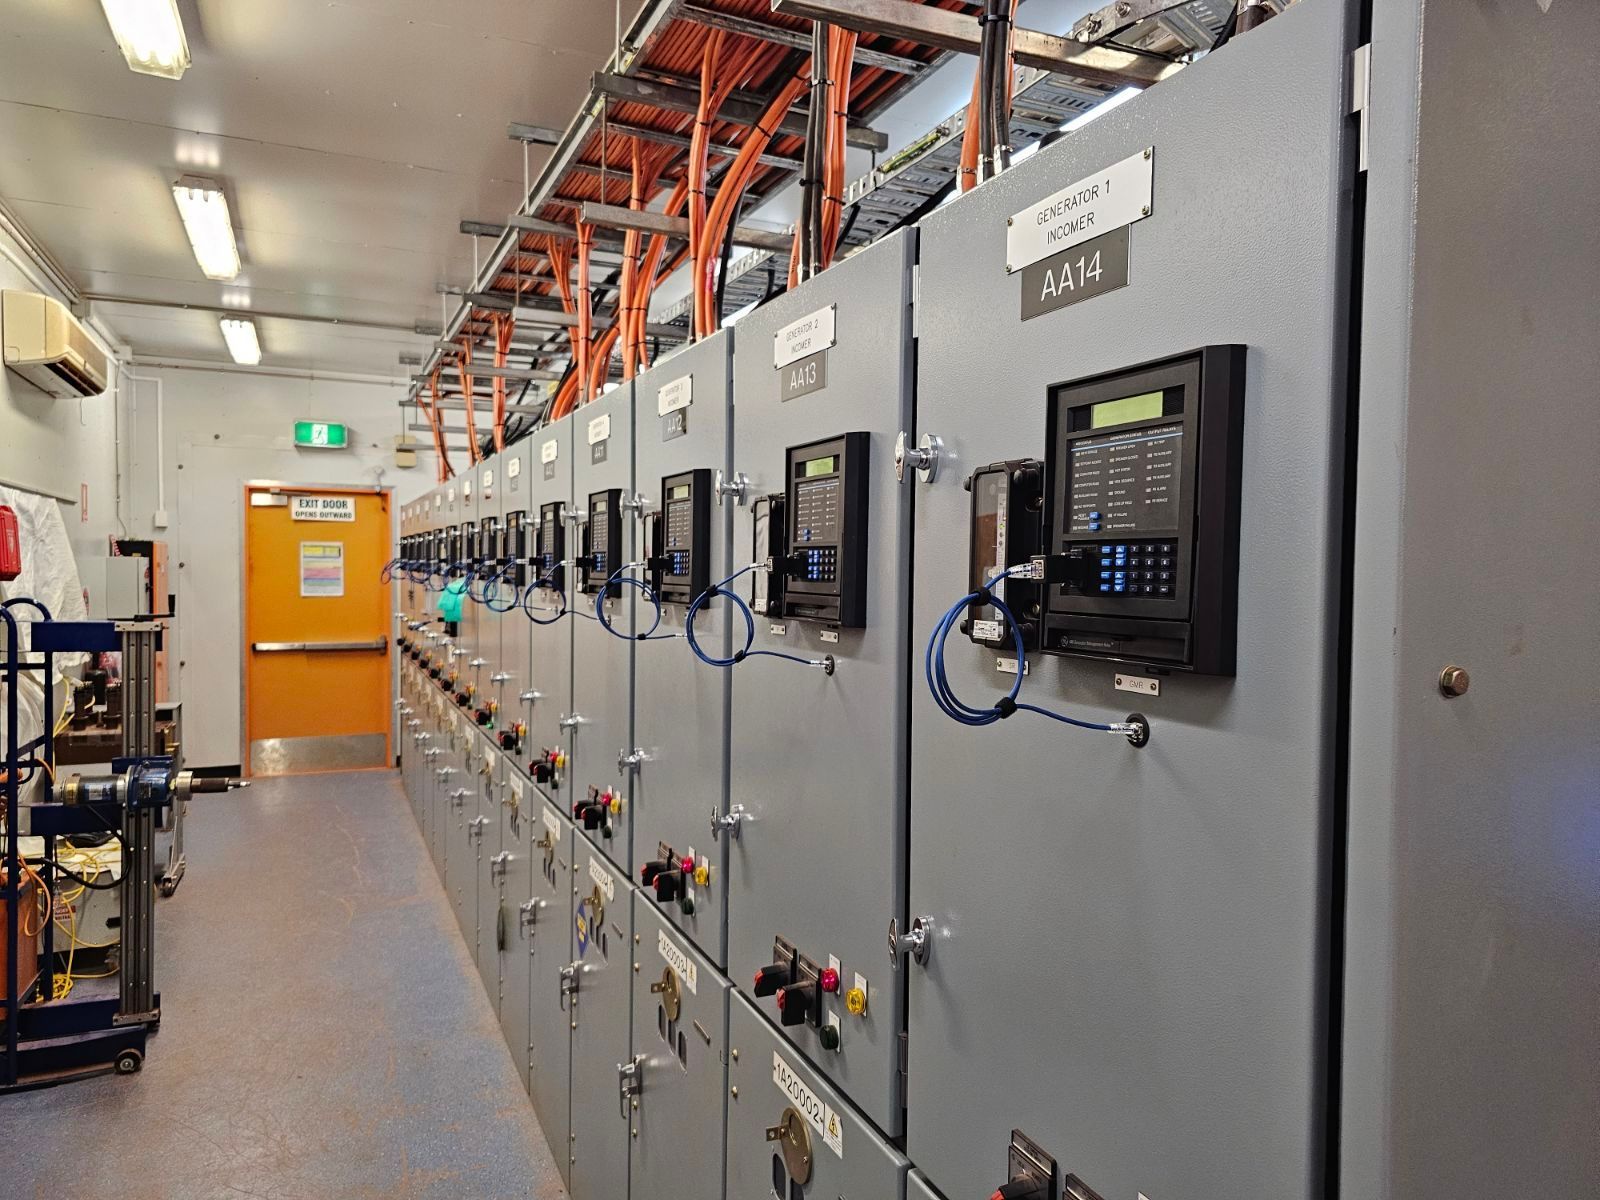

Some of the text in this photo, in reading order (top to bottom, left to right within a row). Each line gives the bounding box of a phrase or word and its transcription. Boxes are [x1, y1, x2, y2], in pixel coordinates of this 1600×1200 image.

[1037, 179, 1111, 225] GENERATOR 1
[1047, 211, 1095, 245] INCOMER
[1040, 249, 1103, 302] AA14
[786, 318, 819, 341] GENERATOR 2
[791, 338, 812, 354] INCOMER
[790, 361, 816, 390] AA13
[299, 499, 348, 509] EXIT DOOR
[320, 511, 352, 519] OUTWARD
